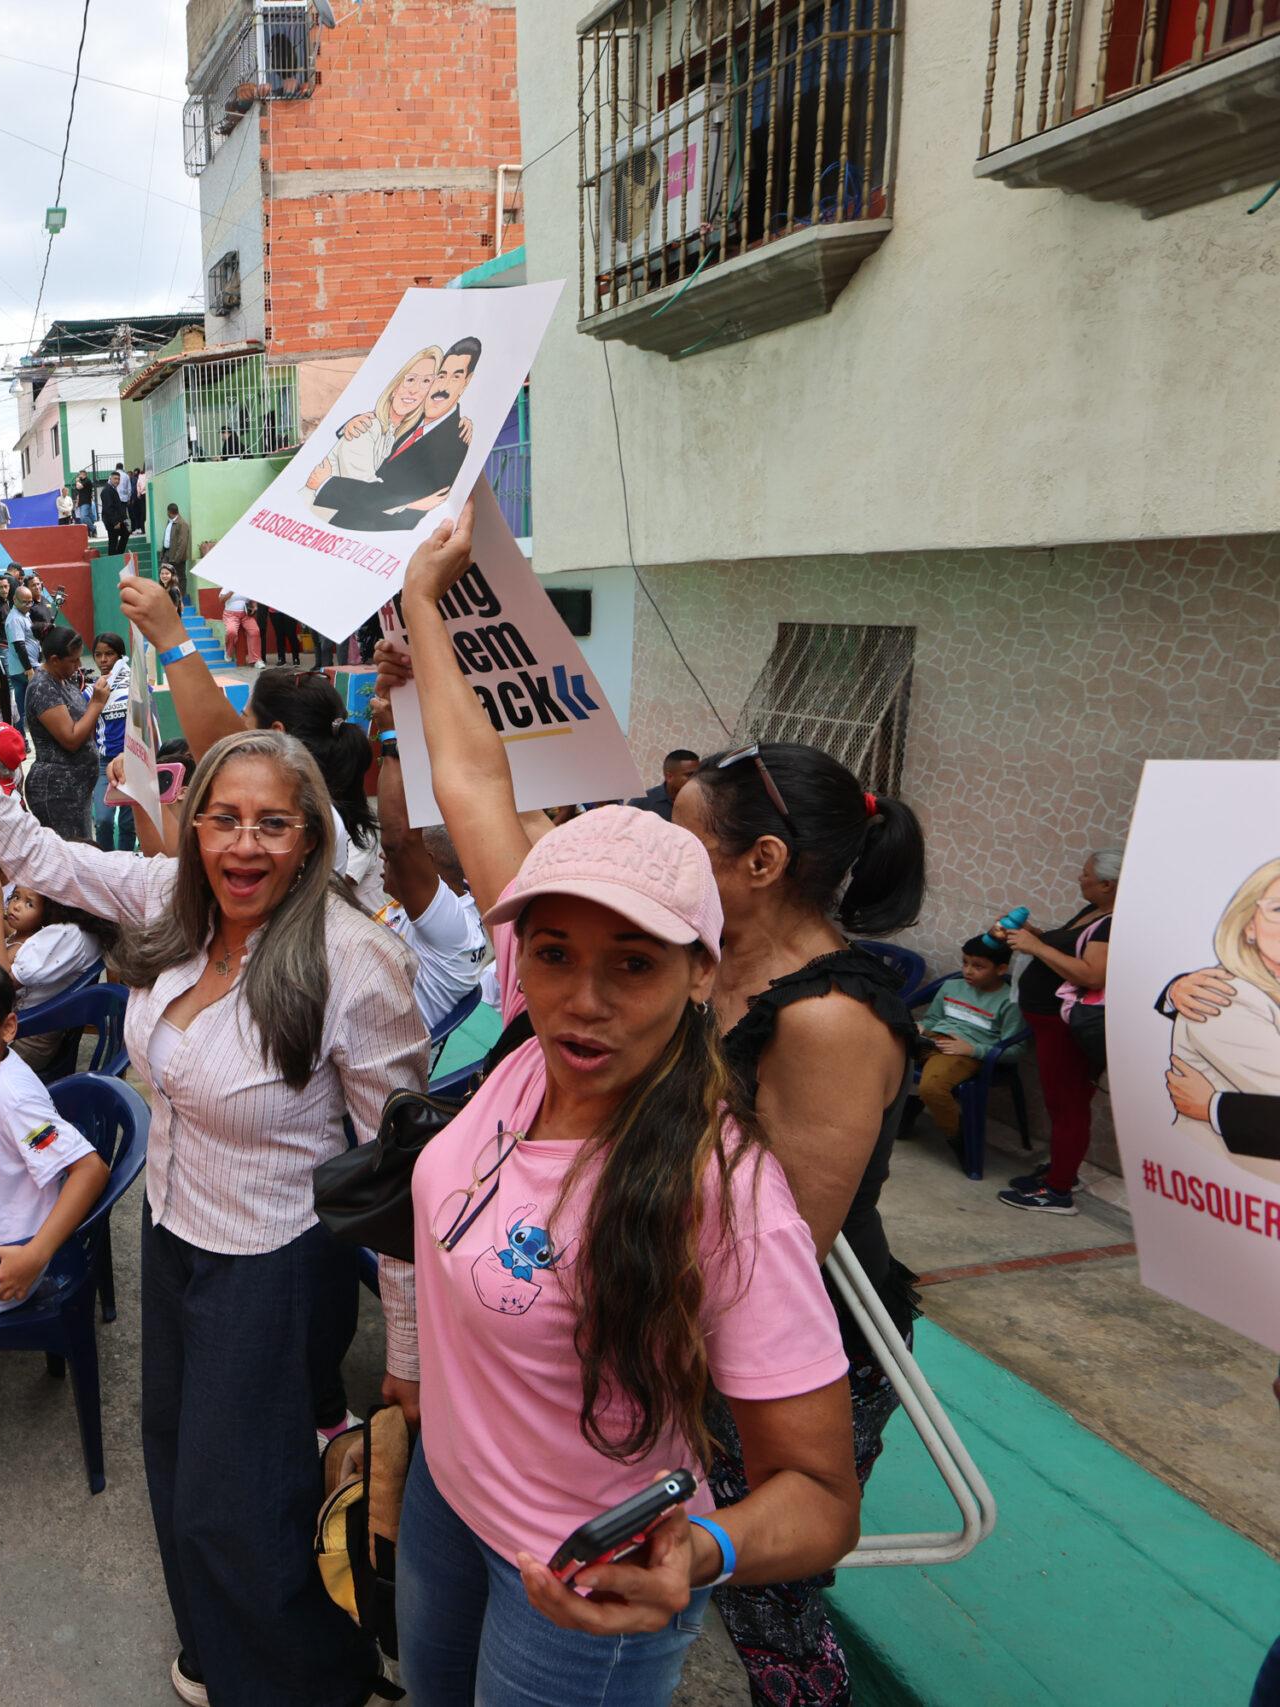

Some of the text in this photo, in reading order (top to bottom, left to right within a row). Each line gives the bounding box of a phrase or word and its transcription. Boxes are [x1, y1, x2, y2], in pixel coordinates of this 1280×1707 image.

[249, 508, 401, 580] #LOSQUEREMOSDEVUELTA
[472, 671, 570, 731] ack
[1143, 1159, 1280, 1242] #LOSQUER
